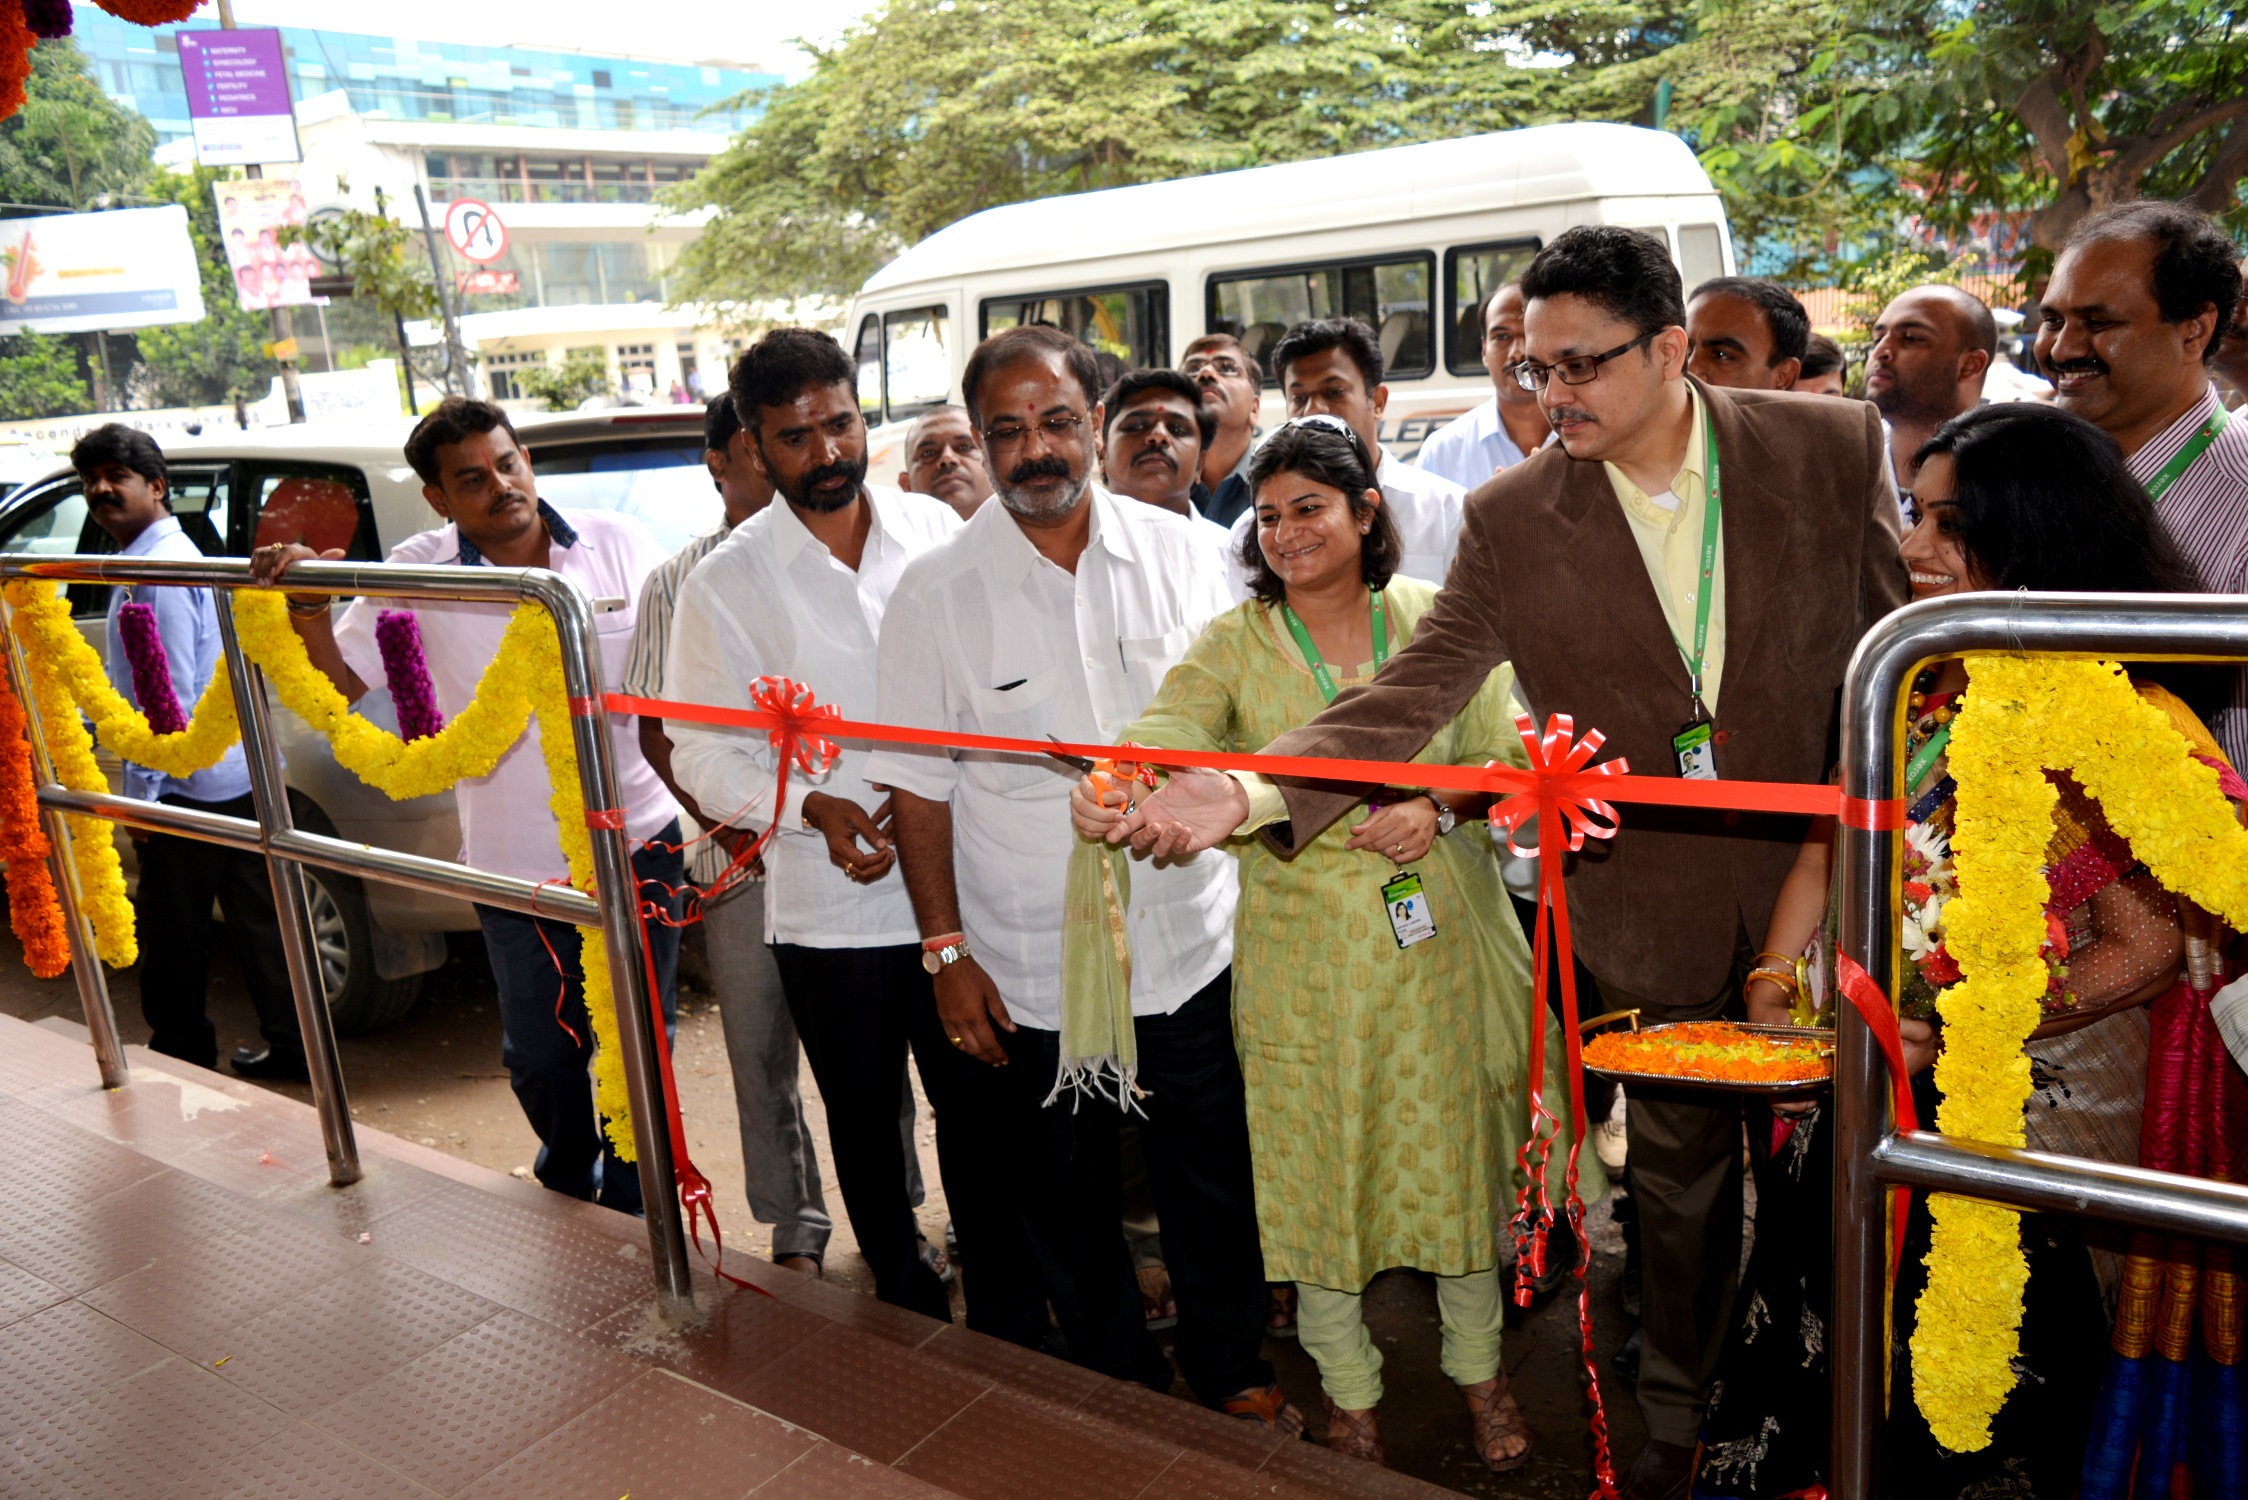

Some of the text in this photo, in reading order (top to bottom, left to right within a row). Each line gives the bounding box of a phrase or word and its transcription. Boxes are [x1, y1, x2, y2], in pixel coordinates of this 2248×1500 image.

[210, 47, 246, 55] MATERNITY
[213, 58, 257, 67] GYNECOLOGY
[235, 70, 266, 78] MEDICINE
[216, 82, 248, 90] FERTILITY
[1712, 464, 1720, 490] xerox
[2148, 473, 2170, 495] xerox
[1705, 544, 1713, 570] xerox
[1286, 606, 1298, 627] xerox
[1697, 623, 1705, 649] xerox
[1316, 668, 1331, 690] xerox
[1906, 757, 1927, 783] xerox
